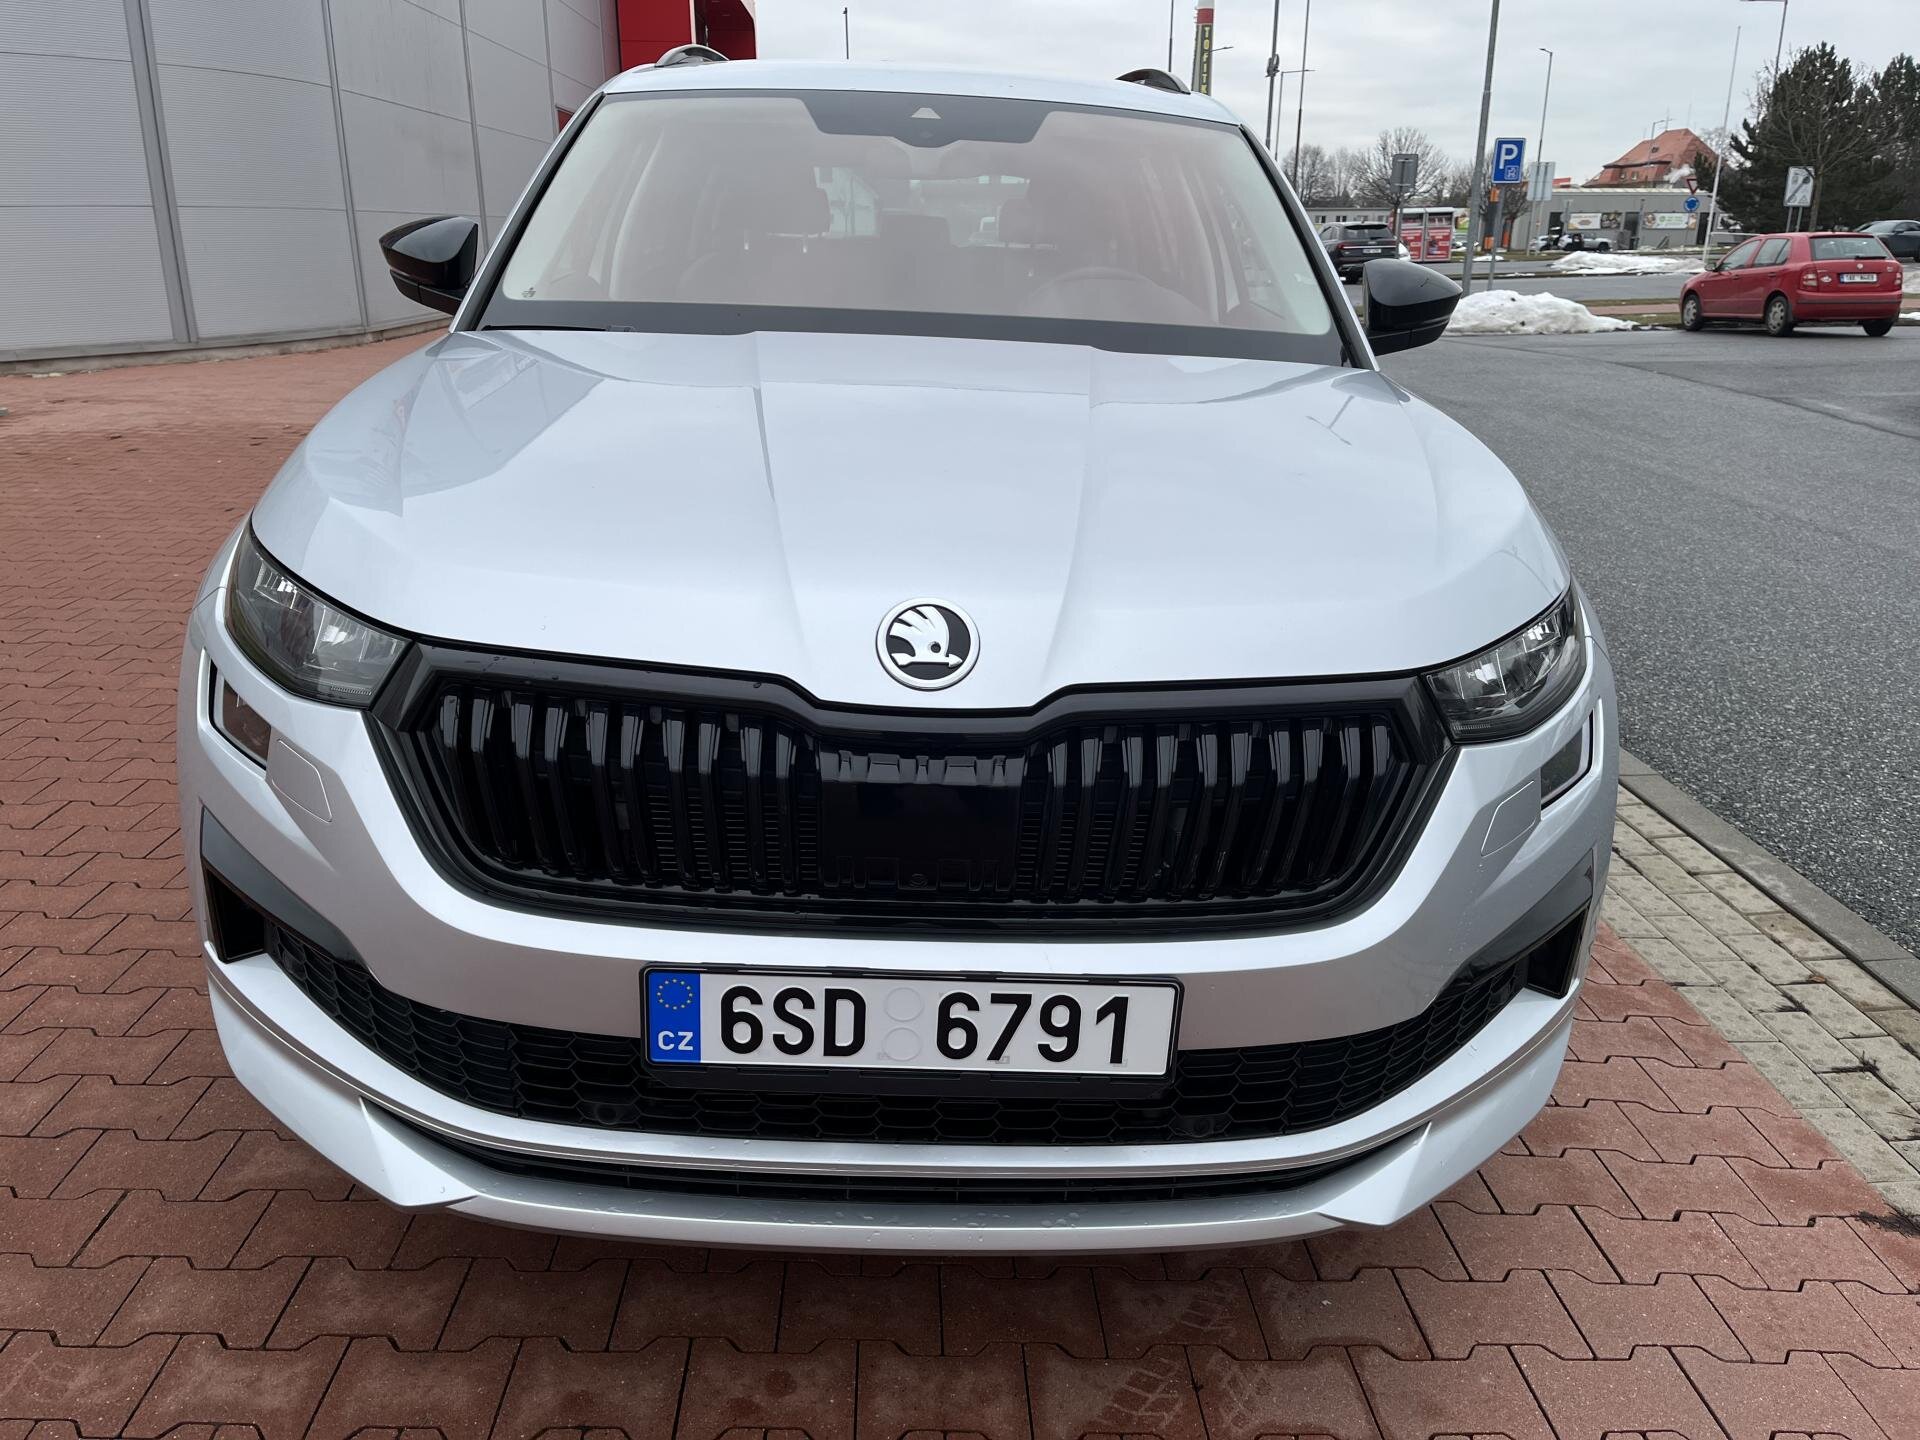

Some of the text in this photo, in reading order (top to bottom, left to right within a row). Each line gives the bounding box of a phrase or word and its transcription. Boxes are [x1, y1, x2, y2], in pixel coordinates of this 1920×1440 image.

[1499, 144, 1518, 170] P
[720, 985, 1130, 1064] 6SD 6791
[657, 1030, 694, 1051] CZ
